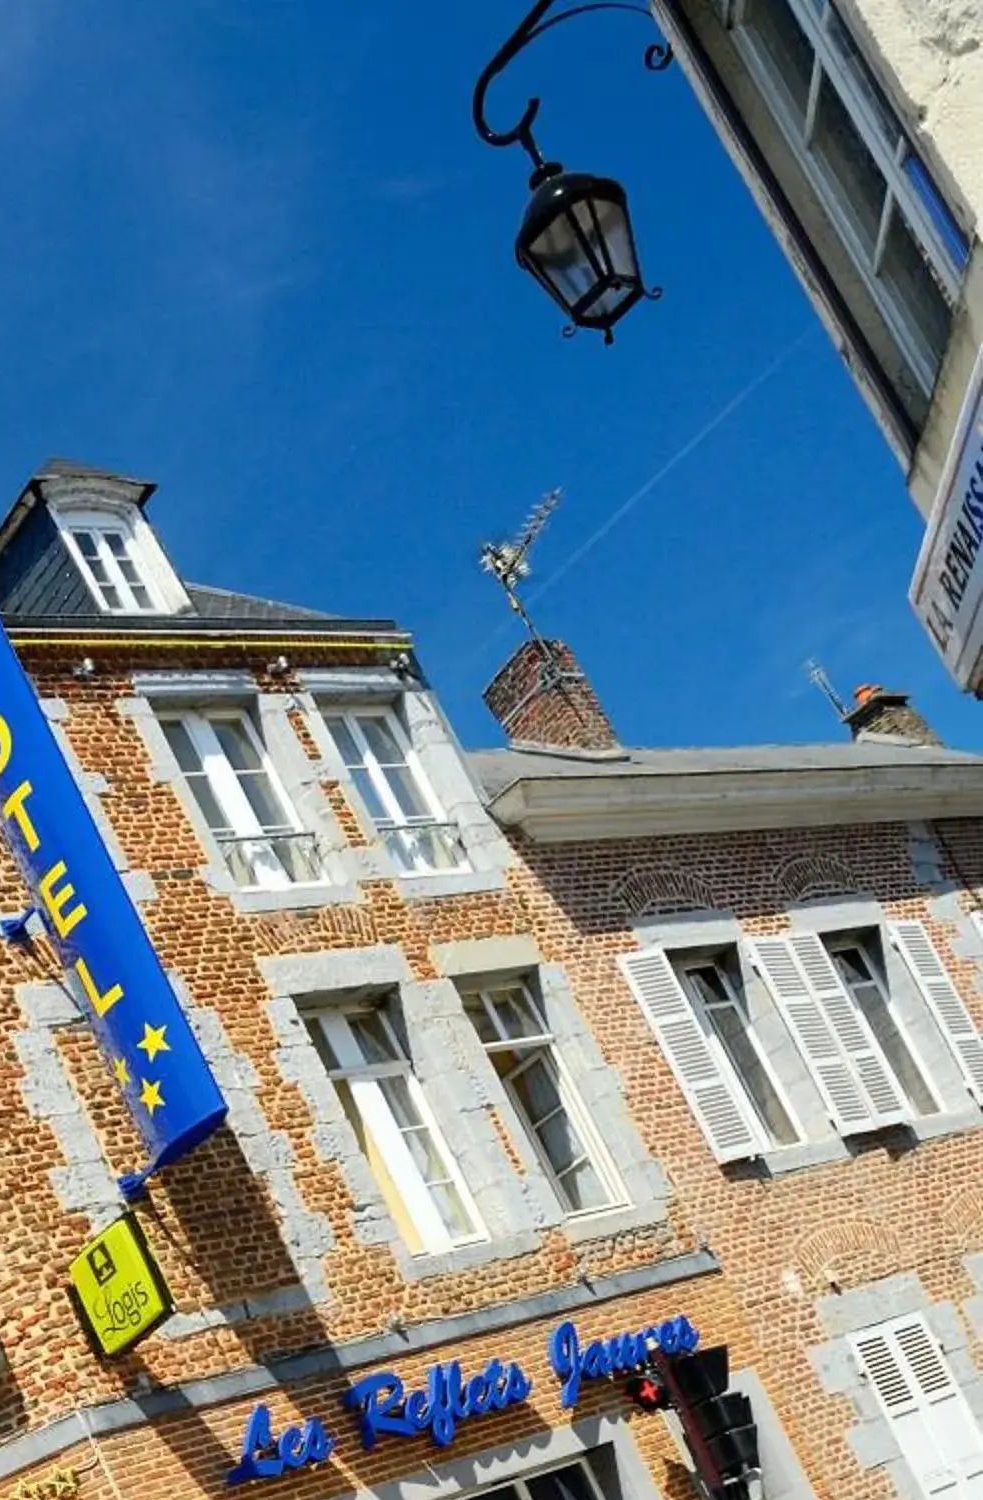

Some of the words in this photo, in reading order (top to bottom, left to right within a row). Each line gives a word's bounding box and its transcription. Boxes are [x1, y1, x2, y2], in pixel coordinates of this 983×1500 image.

[926, 600, 954, 654] LA
[227, 1403, 334, 1486] Les
[343, 1357, 532, 1449] Reflets
